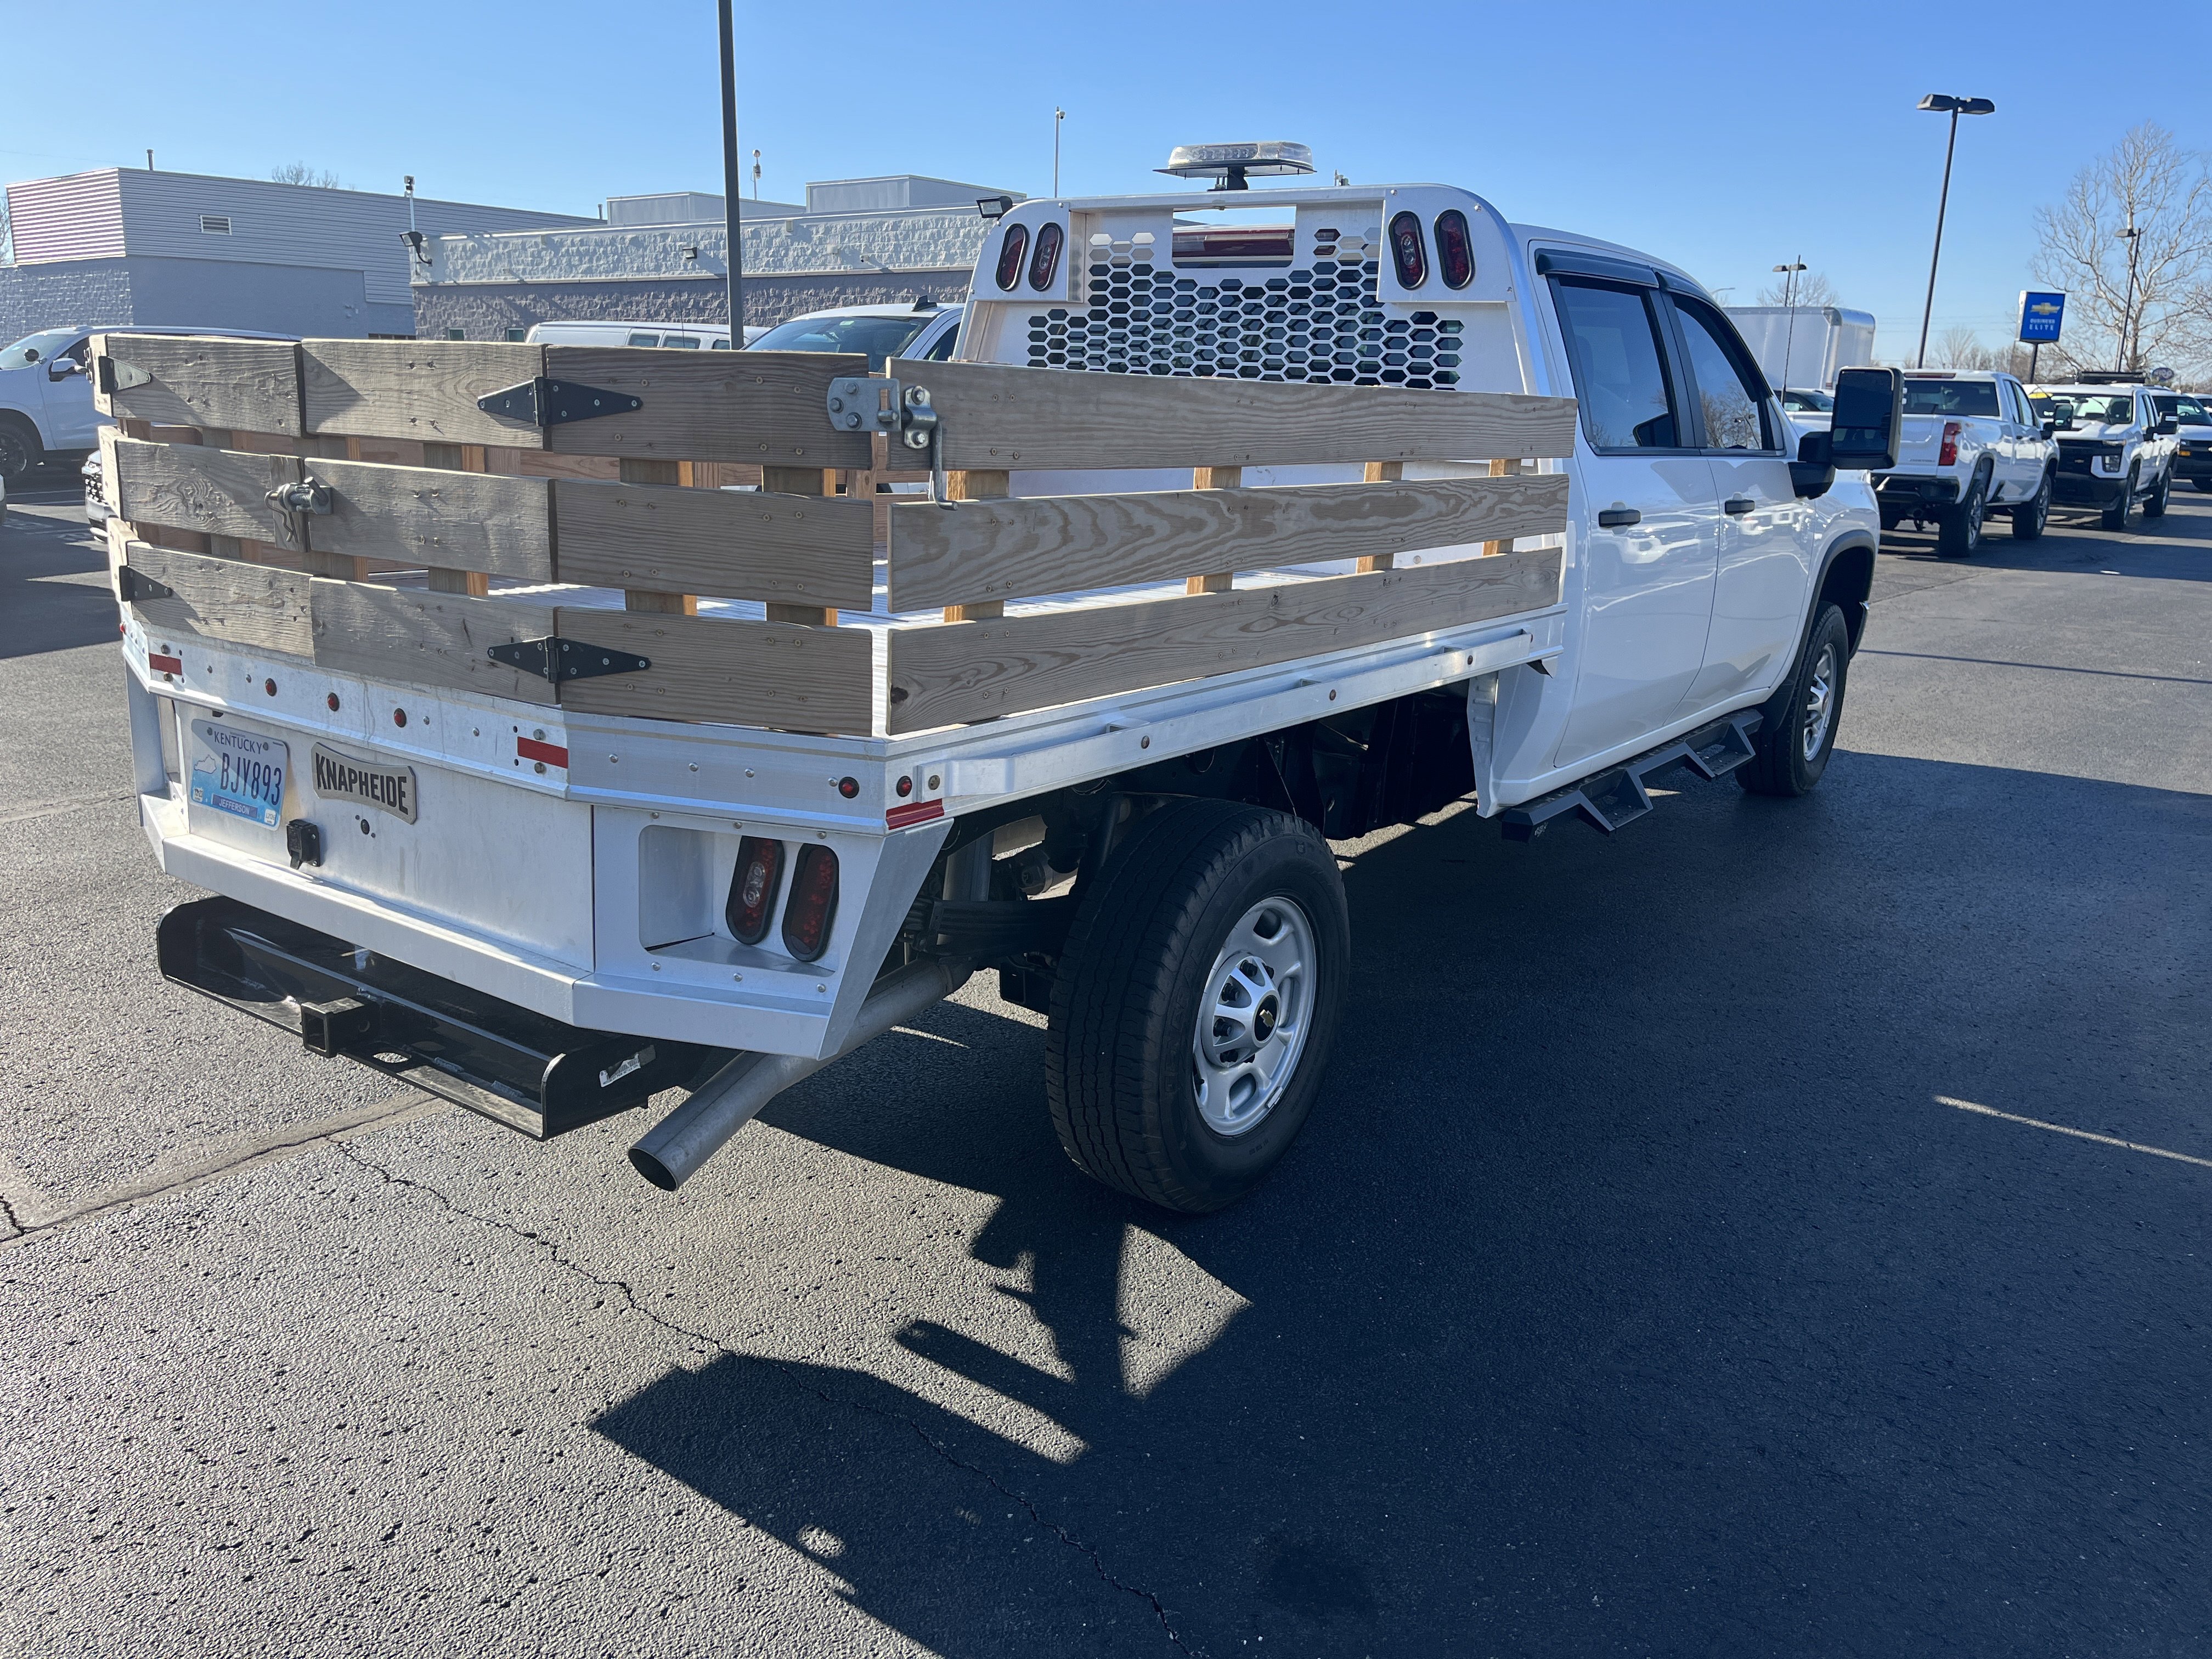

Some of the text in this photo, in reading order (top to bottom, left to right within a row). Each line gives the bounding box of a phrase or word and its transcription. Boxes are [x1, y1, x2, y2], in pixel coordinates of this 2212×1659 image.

[214, 731, 262, 754] KENTUCKY
[220, 752, 282, 805] BJY893
[315, 752, 408, 815] KNAPHEIDE
[219, 798, 250, 815] JEFFERSON
